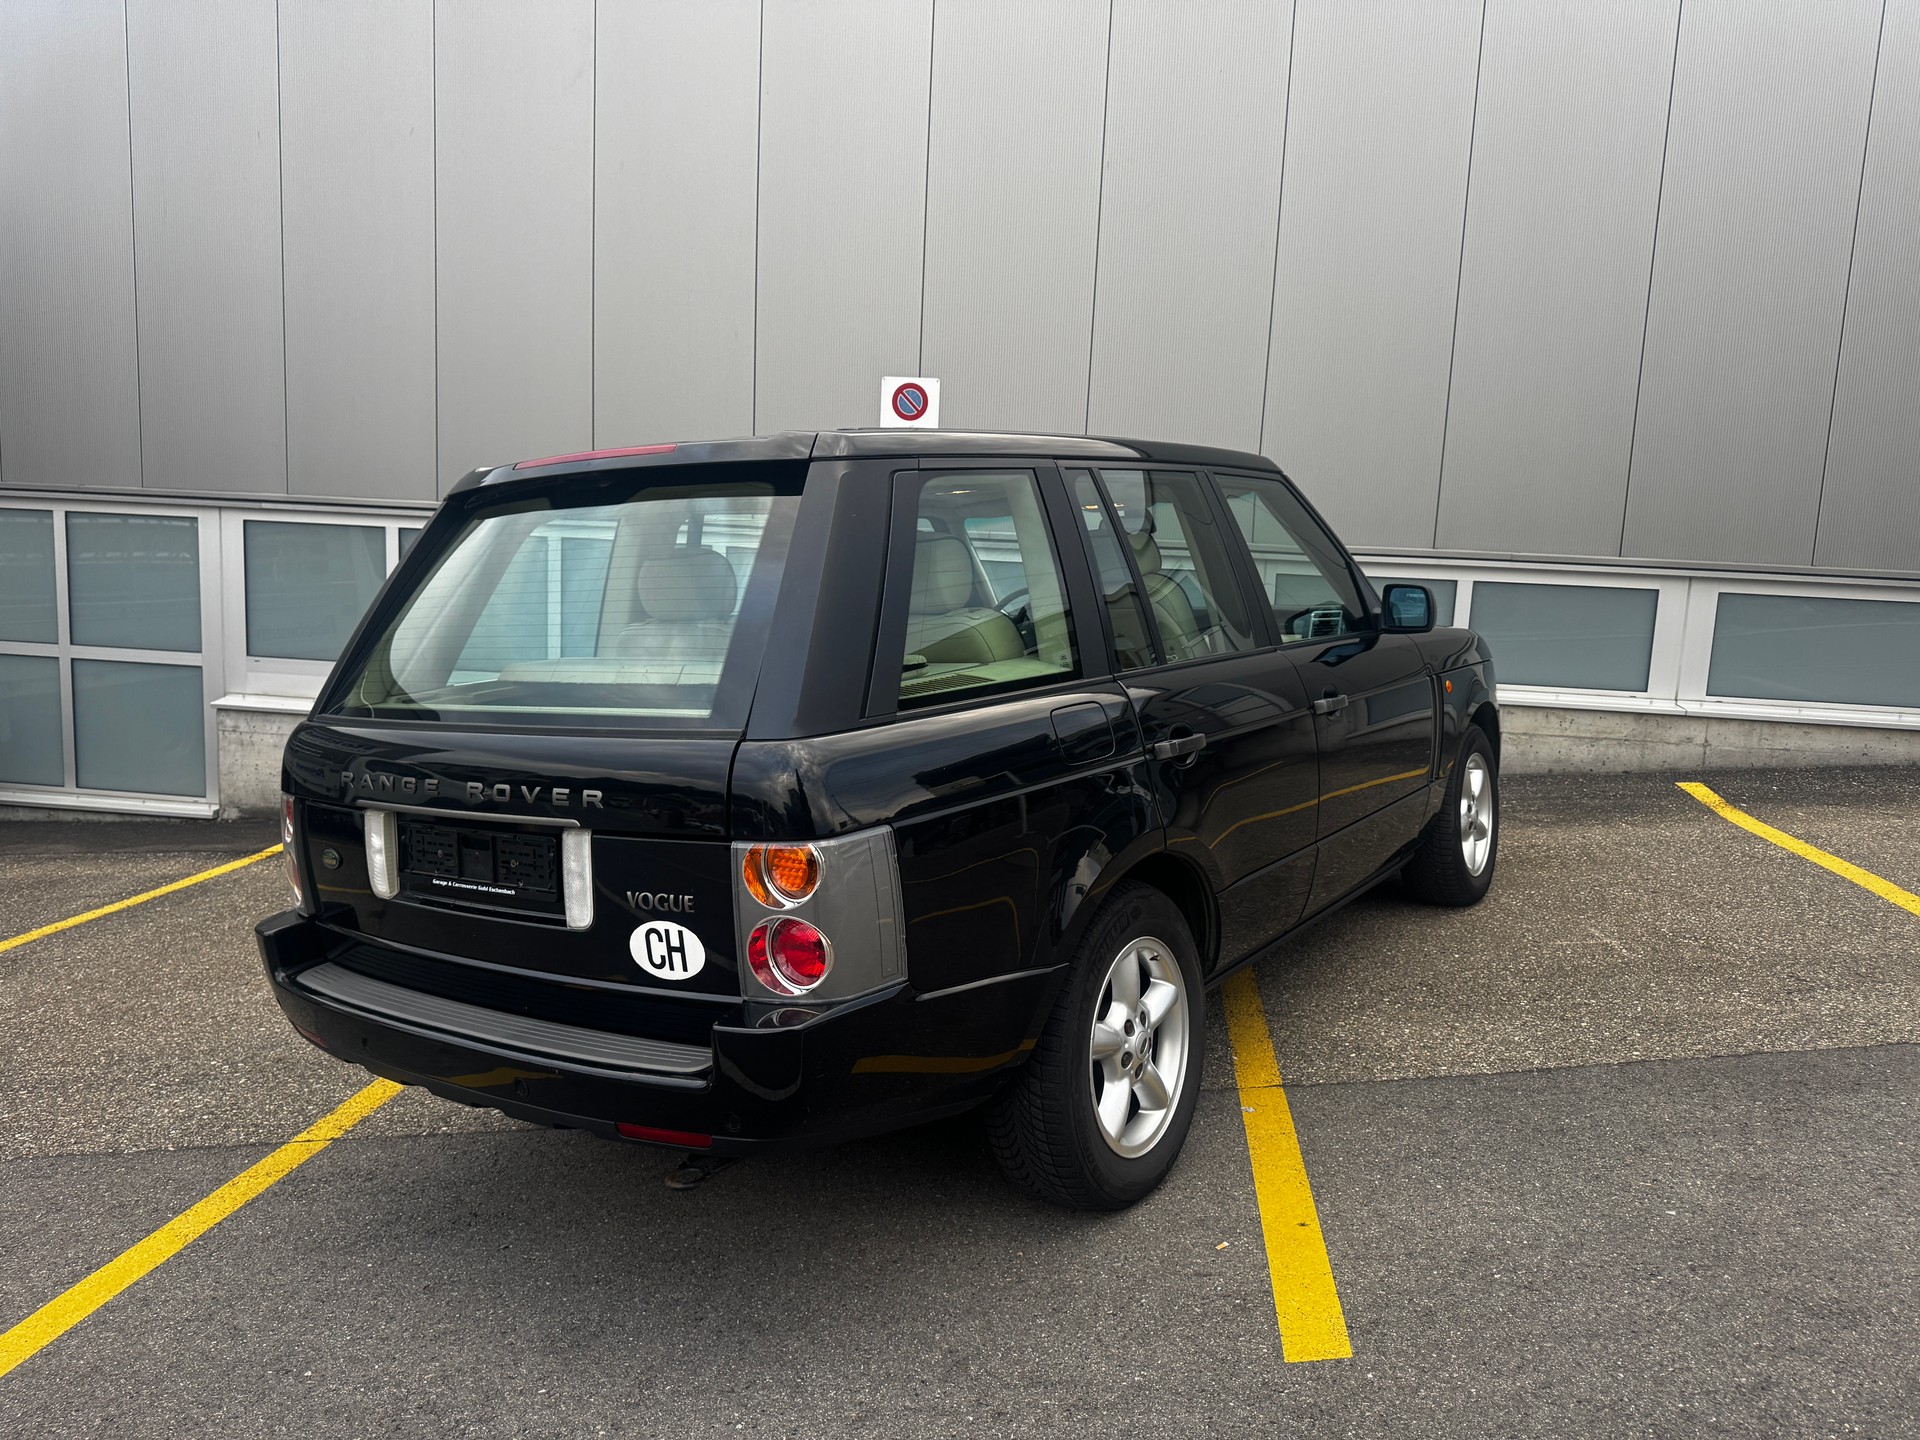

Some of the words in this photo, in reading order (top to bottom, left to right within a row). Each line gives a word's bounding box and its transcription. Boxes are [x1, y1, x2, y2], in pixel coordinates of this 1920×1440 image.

[340, 771, 440, 796] RANGE
[466, 781, 604, 809] ROVER
[432, 878, 448, 887] Garage
[452, 881, 478, 890] Carrosserie
[488, 886, 516, 896] Eschenbach
[626, 890, 696, 914] VOGUE
[644, 927, 689, 973] CH
